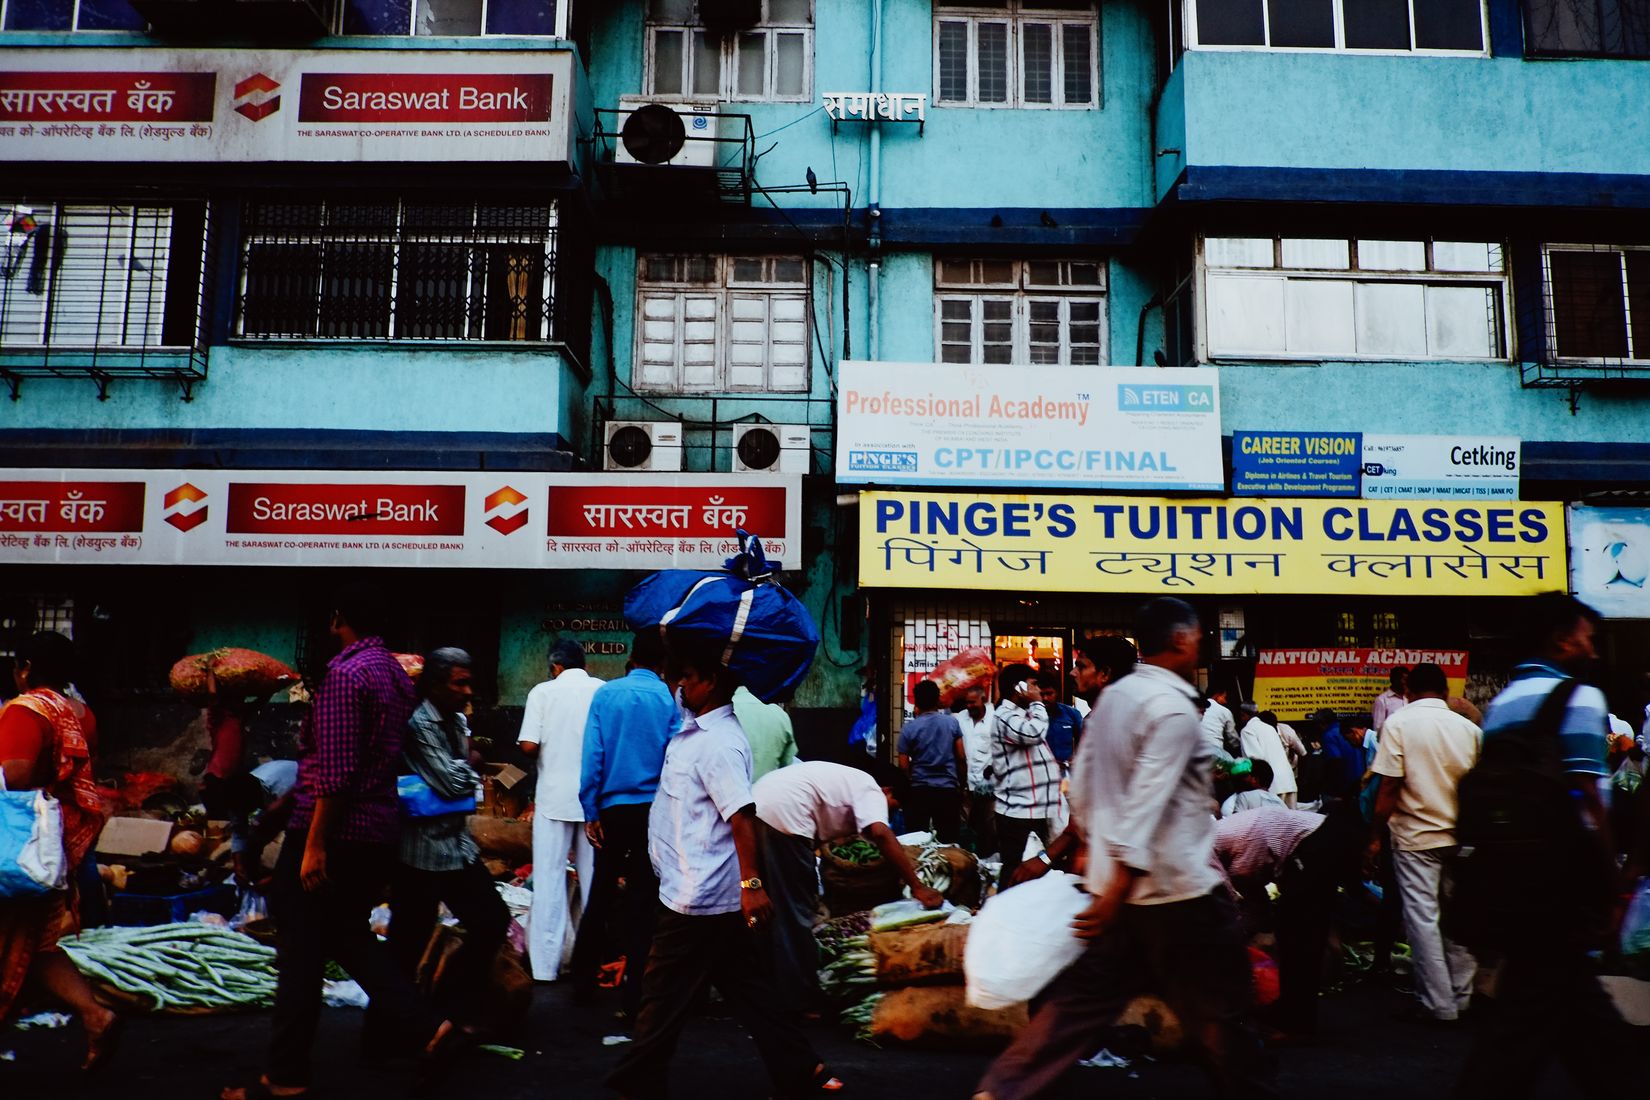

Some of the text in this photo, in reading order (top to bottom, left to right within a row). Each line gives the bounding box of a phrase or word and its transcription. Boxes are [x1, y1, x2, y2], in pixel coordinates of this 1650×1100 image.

[127, 80, 176, 113] बँक
[322, 86, 528, 110] Saraswat Bank
[822, 92, 927, 120] समाधान
[524, 129, 551, 137] BANK)
[846, 390, 981, 418] Professional
[988, 394, 1089, 426] Academy
[1142, 391, 1211, 406] ETEN CA
[1241, 436, 1356, 455] CAREER VISION
[1450, 445, 1516, 471] Cetking
[933, 447, 1177, 472] CPT/IPCC/FINAL
[60, 490, 107, 524] बँक
[252, 497, 439, 522] Saraswat Bank
[583, 494, 749, 529] सारस्वत बँक
[876, 499, 1549, 543] PINGE'S TUITION CLASSES
[284, 541, 341, 549] CO-OPERATIVE
[439, 543, 465, 551] BANK)
[561, 541, 602, 553] सारस्वत
[1089, 551, 1287, 587] ट्यूशन
[1320, 545, 1550, 580] क्लासेस
[601, 641, 625, 654] LTD
[1258, 650, 1466, 666] NATIONAL ACADEMY
